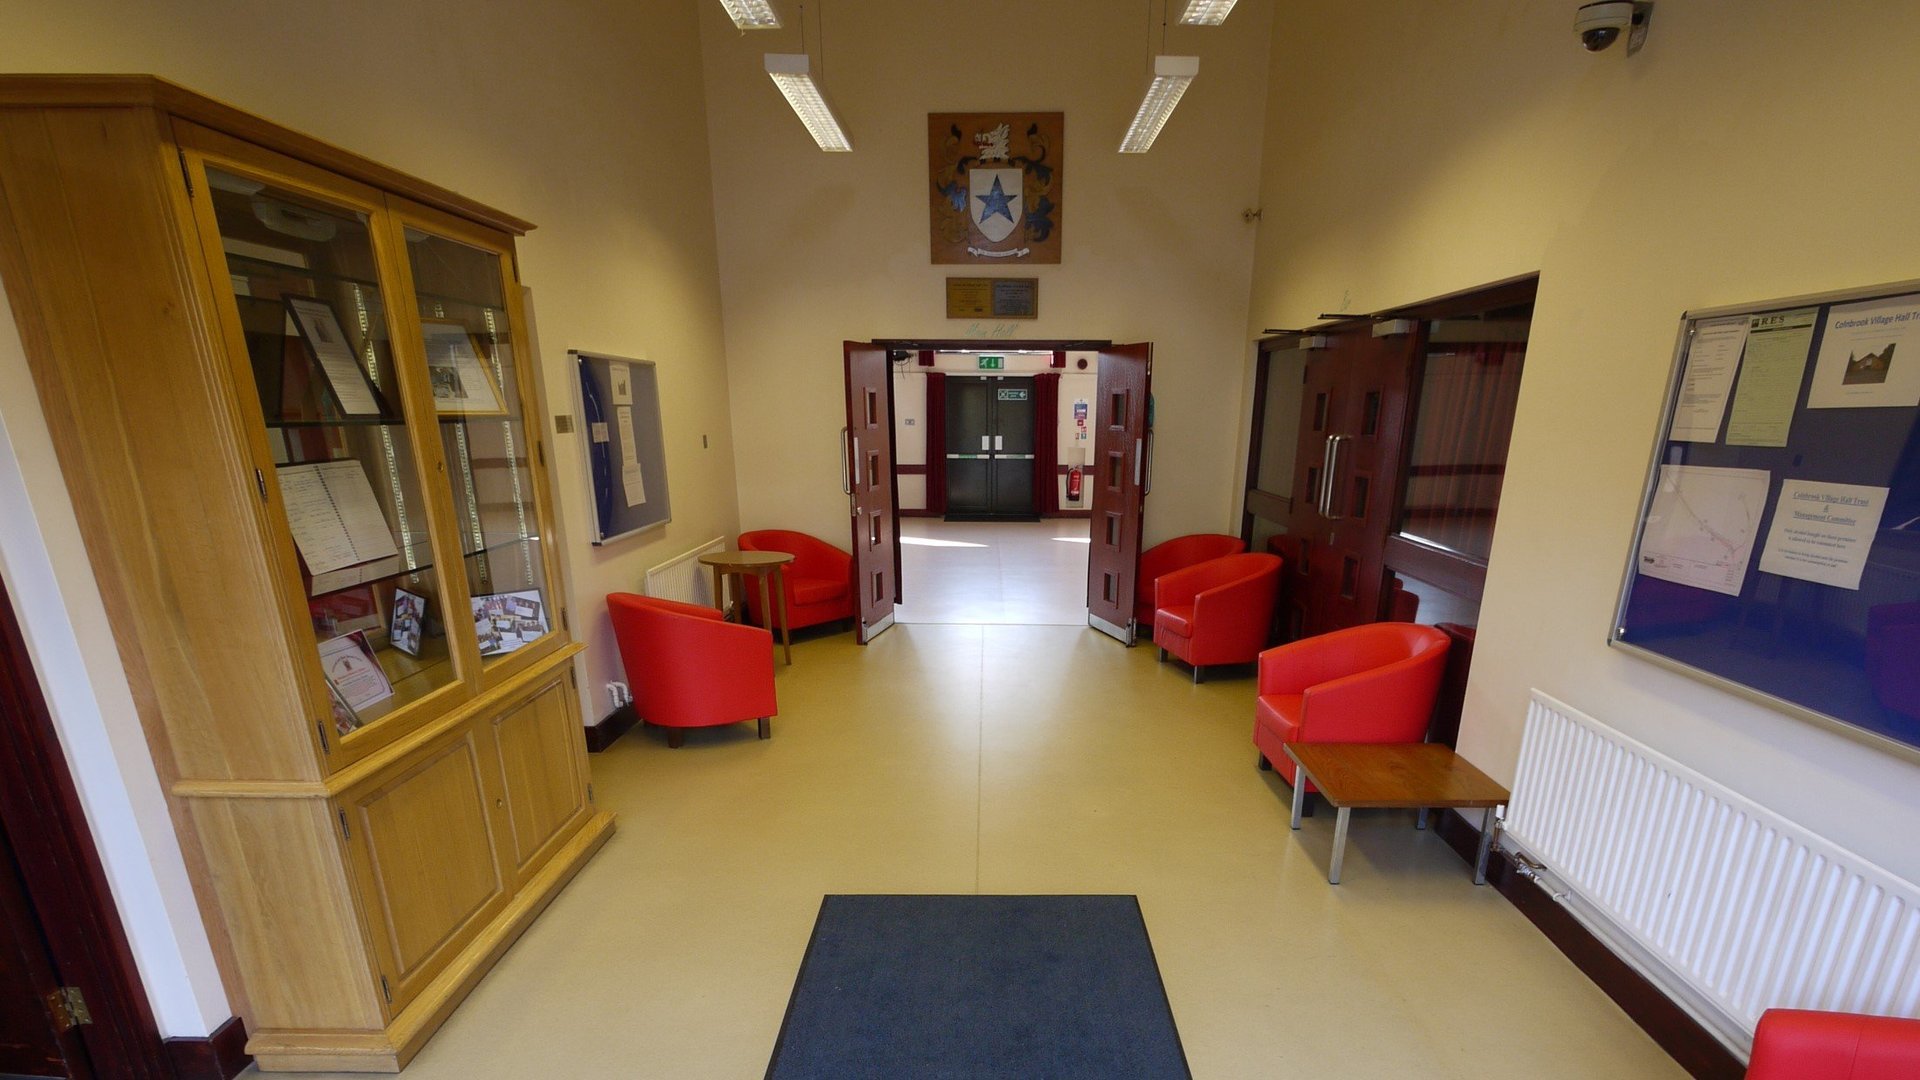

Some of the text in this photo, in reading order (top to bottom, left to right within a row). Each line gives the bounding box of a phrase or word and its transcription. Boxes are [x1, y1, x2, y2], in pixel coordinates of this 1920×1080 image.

[1761, 315, 1785, 326] RES
[1835, 317, 1868, 329] Colnbrook
[1870, 315, 1893, 325] Village
[1894, 311, 1910, 322] Hall
